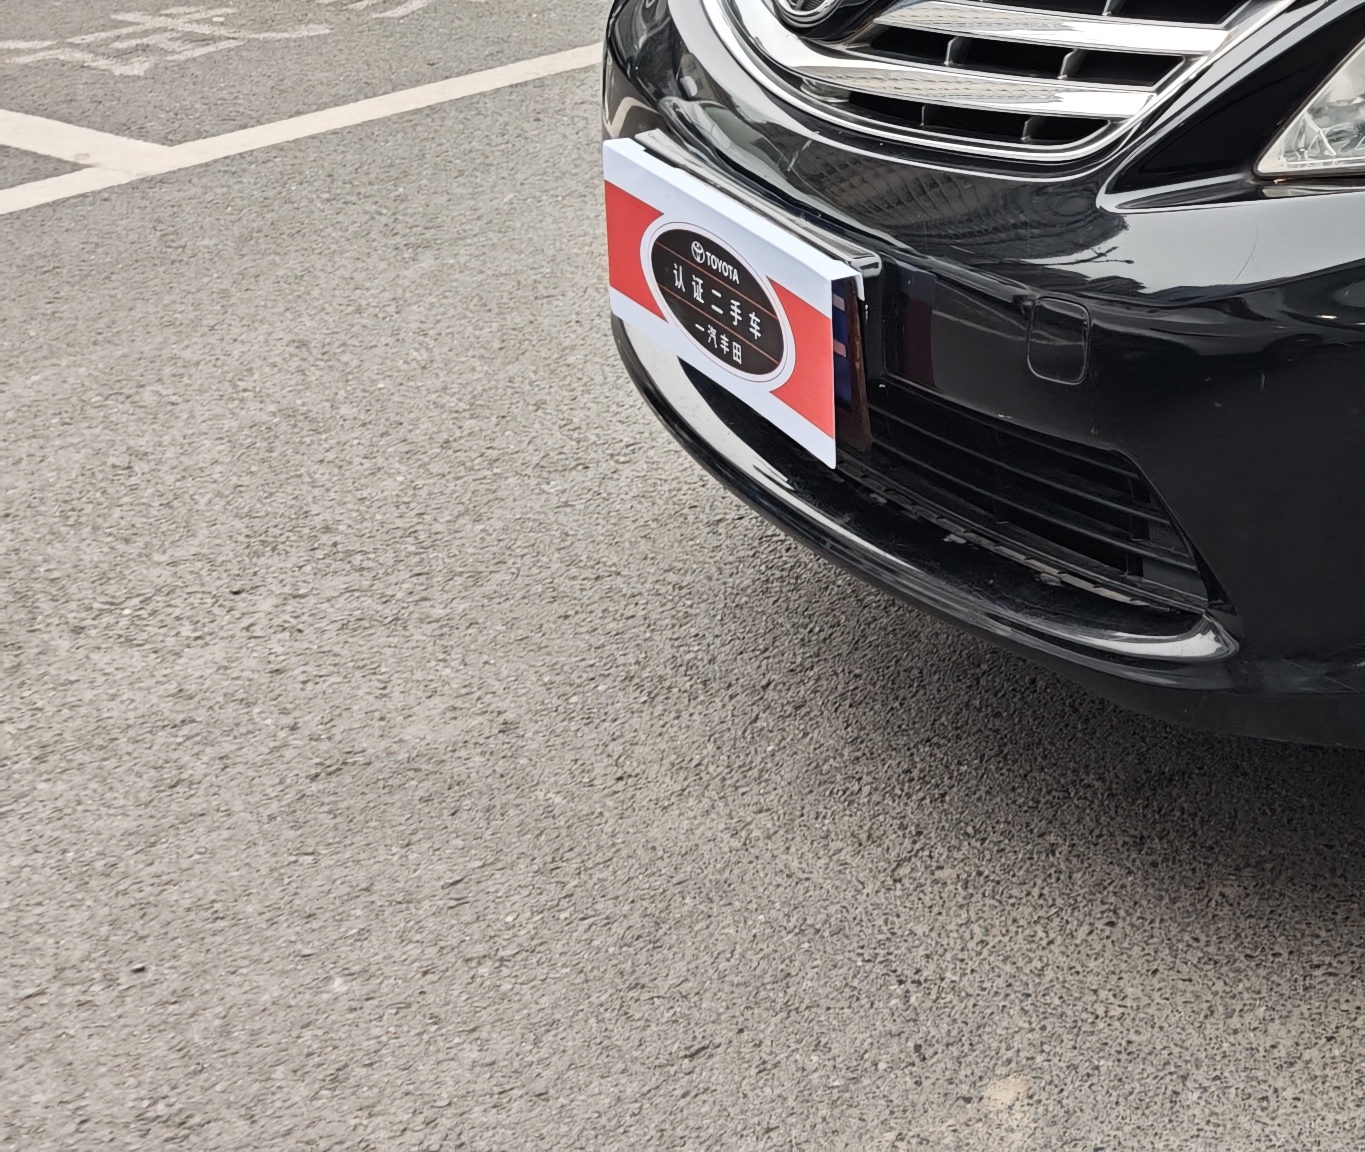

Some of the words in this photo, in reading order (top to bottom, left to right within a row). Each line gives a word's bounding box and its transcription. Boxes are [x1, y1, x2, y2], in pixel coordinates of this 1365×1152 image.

[705, 250, 740, 285] TOYOTA
[672, 263, 762, 340] 认证二手车
[694, 323, 743, 365] 一汽丰田
